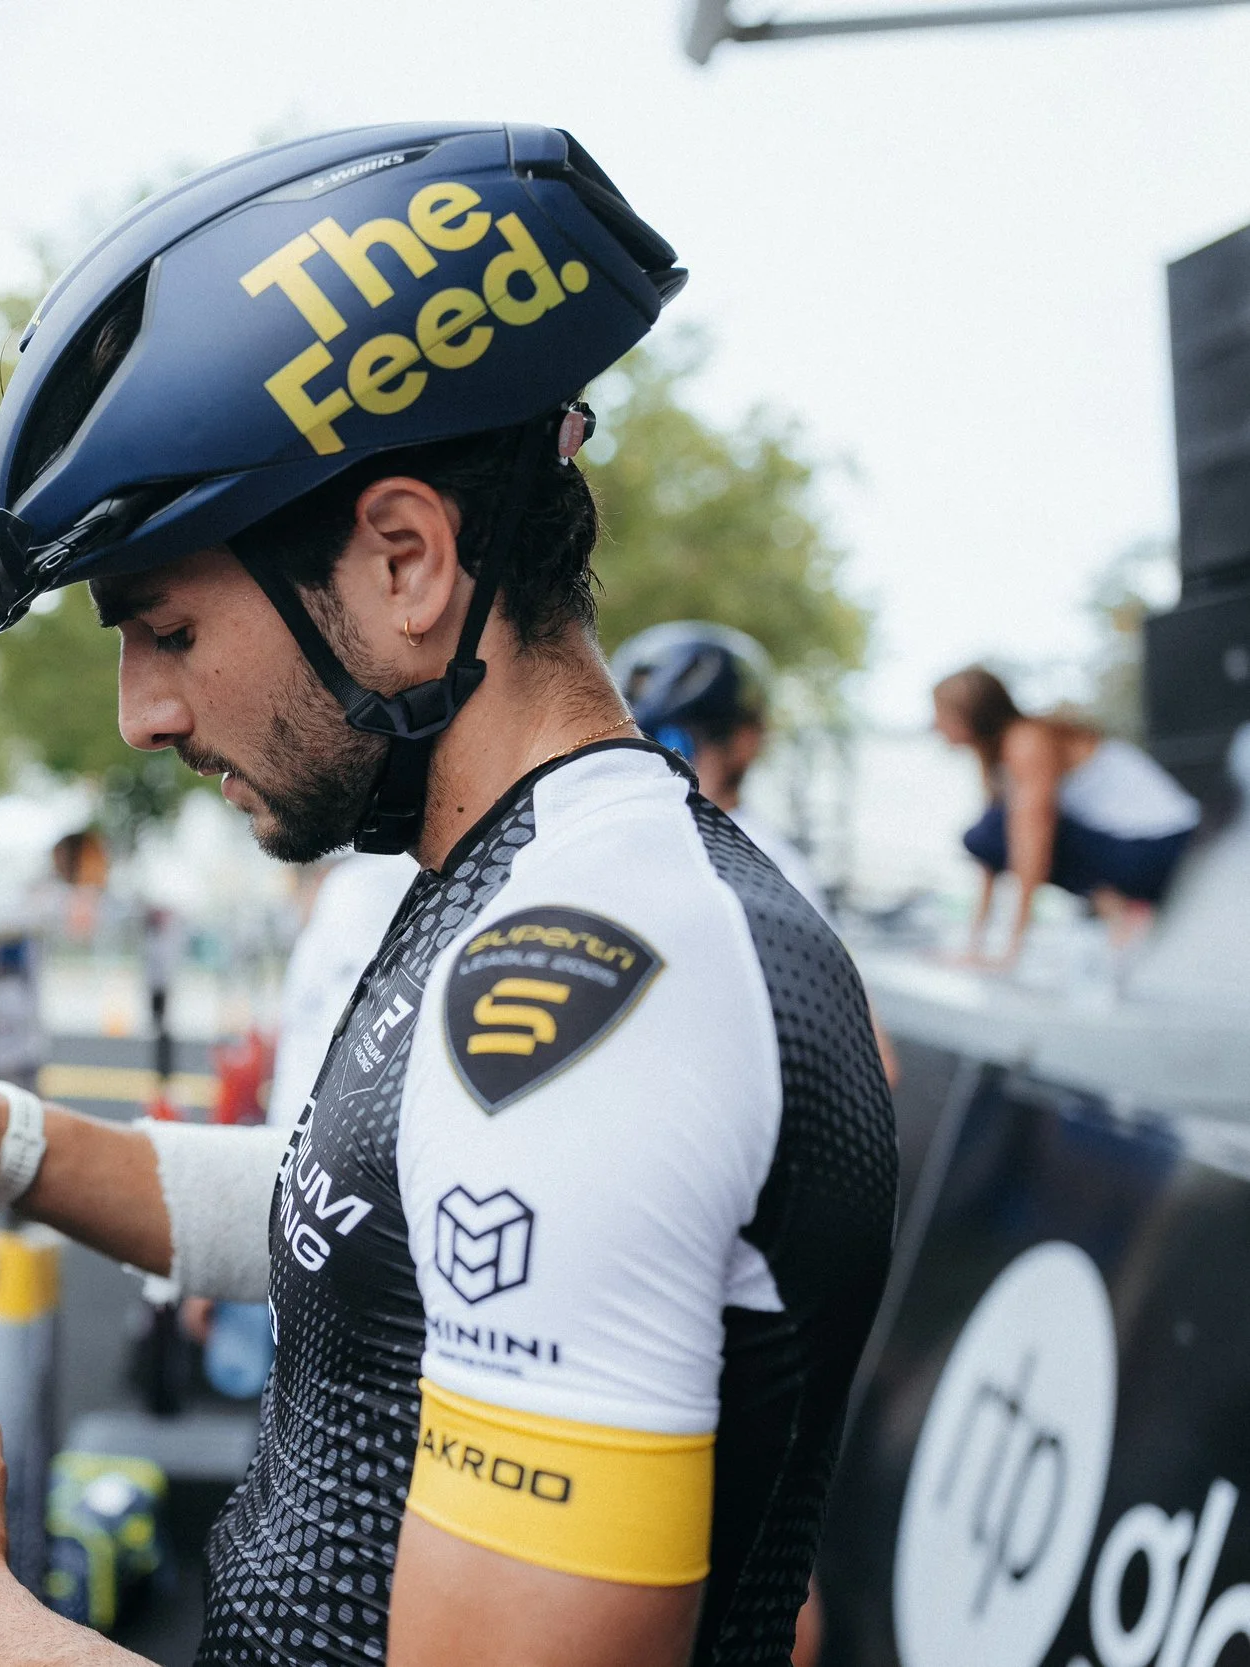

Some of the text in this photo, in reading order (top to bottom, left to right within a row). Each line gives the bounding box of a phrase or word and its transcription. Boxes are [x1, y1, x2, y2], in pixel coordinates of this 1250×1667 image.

[312, 155, 405, 190] S-WORKS
[239, 181, 492, 345] The
[263, 211, 590, 456] Feed.
[353, 1044, 374, 1073] RACING
[361, 1031, 386, 1065] PODIUM
